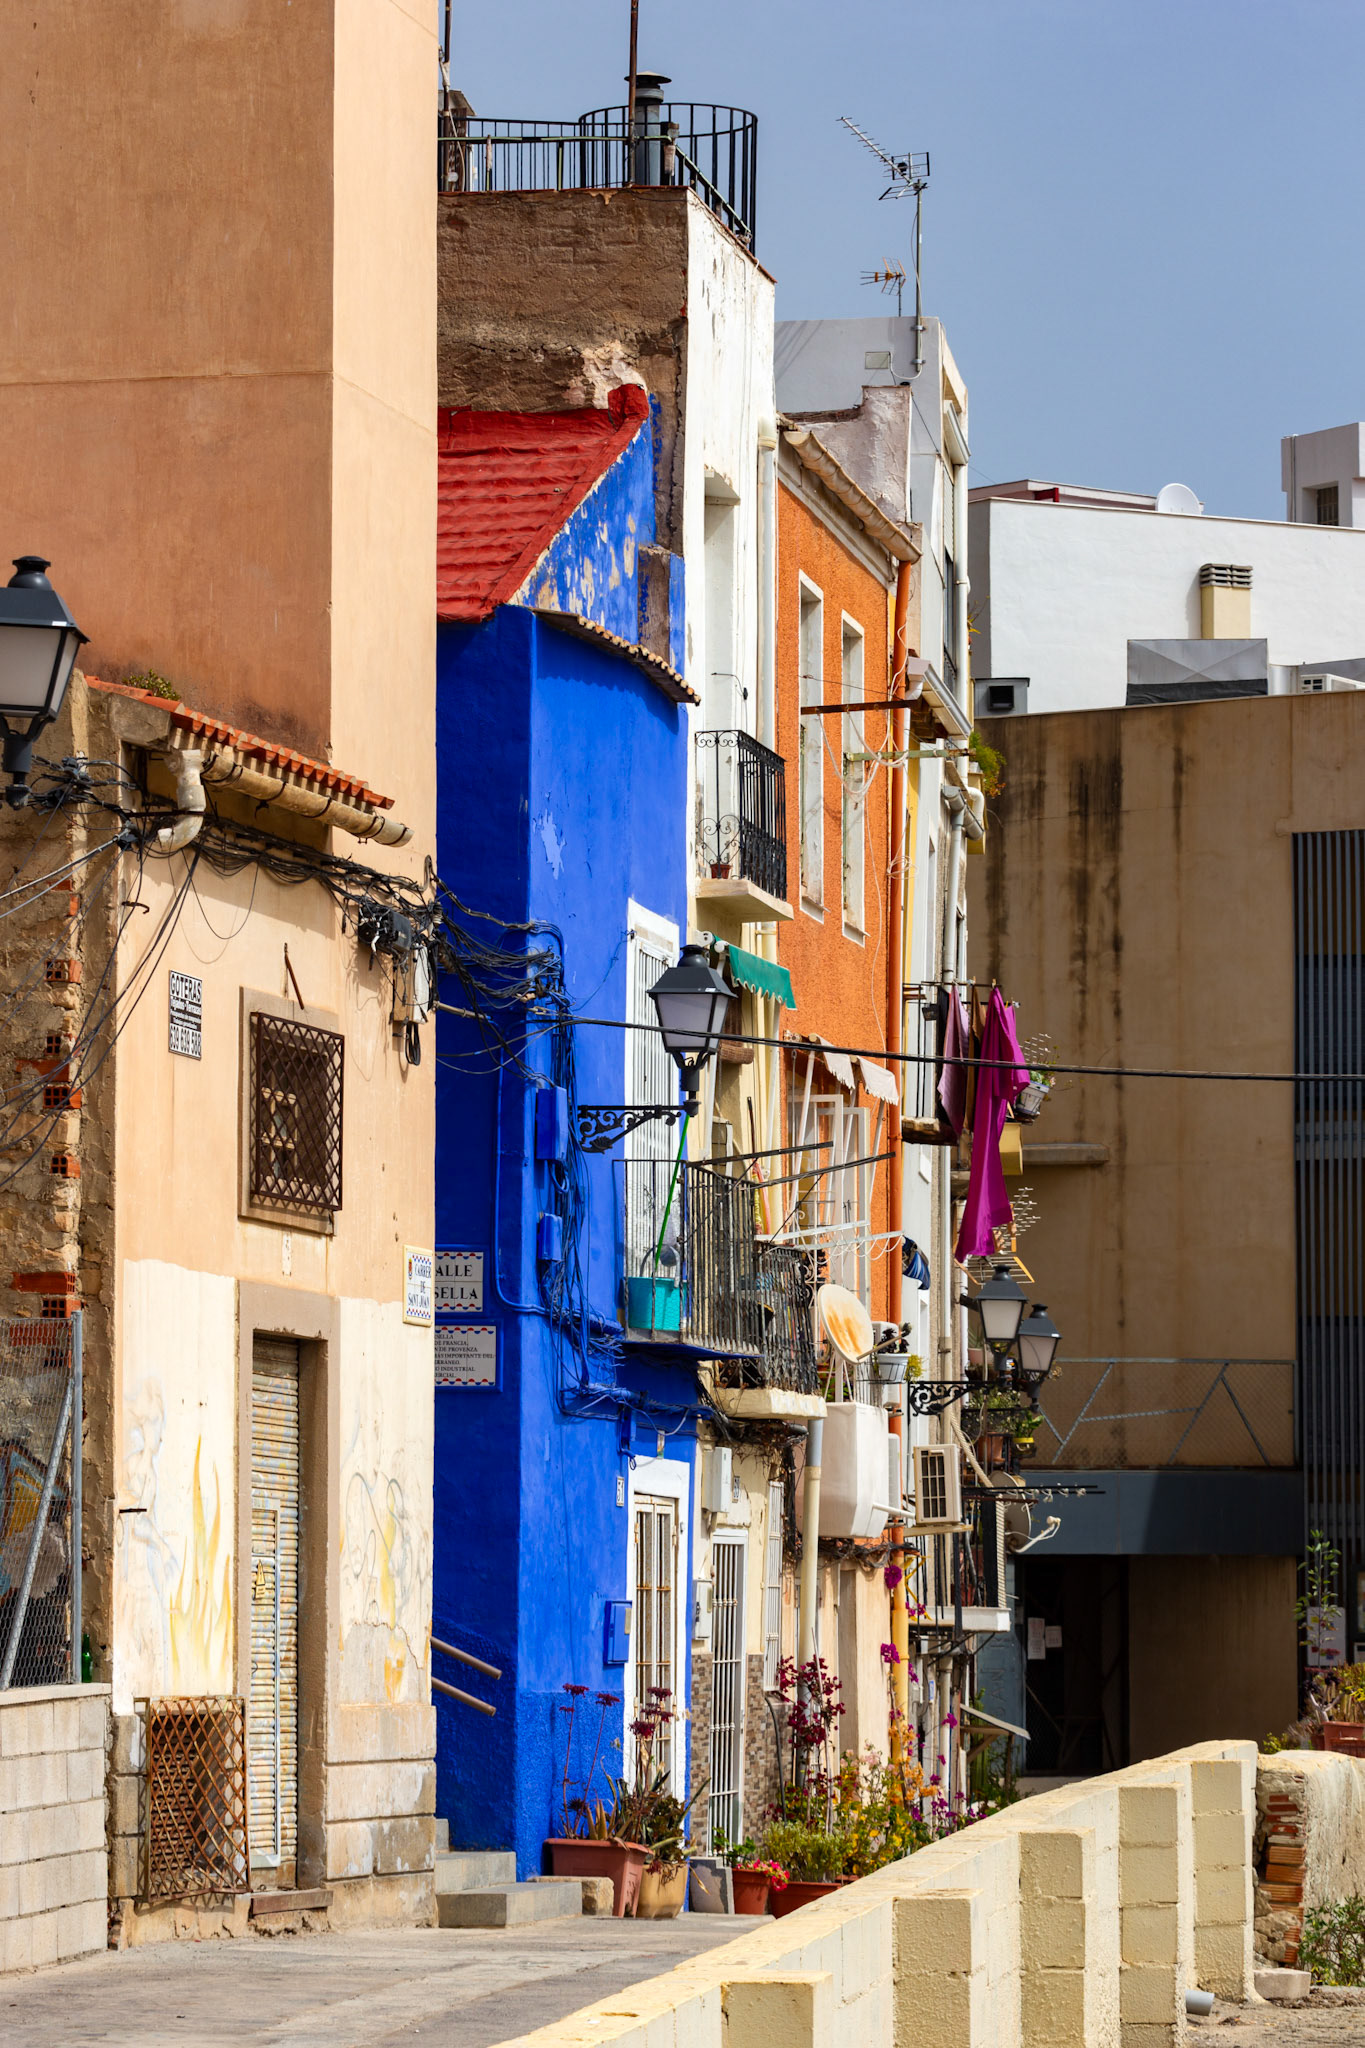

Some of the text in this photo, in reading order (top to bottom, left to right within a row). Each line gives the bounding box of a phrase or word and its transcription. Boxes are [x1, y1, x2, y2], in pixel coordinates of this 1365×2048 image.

[171, 974, 201, 1003] GOTERAS
[415, 1263, 431, 1278] CARRER
[420, 1281, 426, 1294] DE
